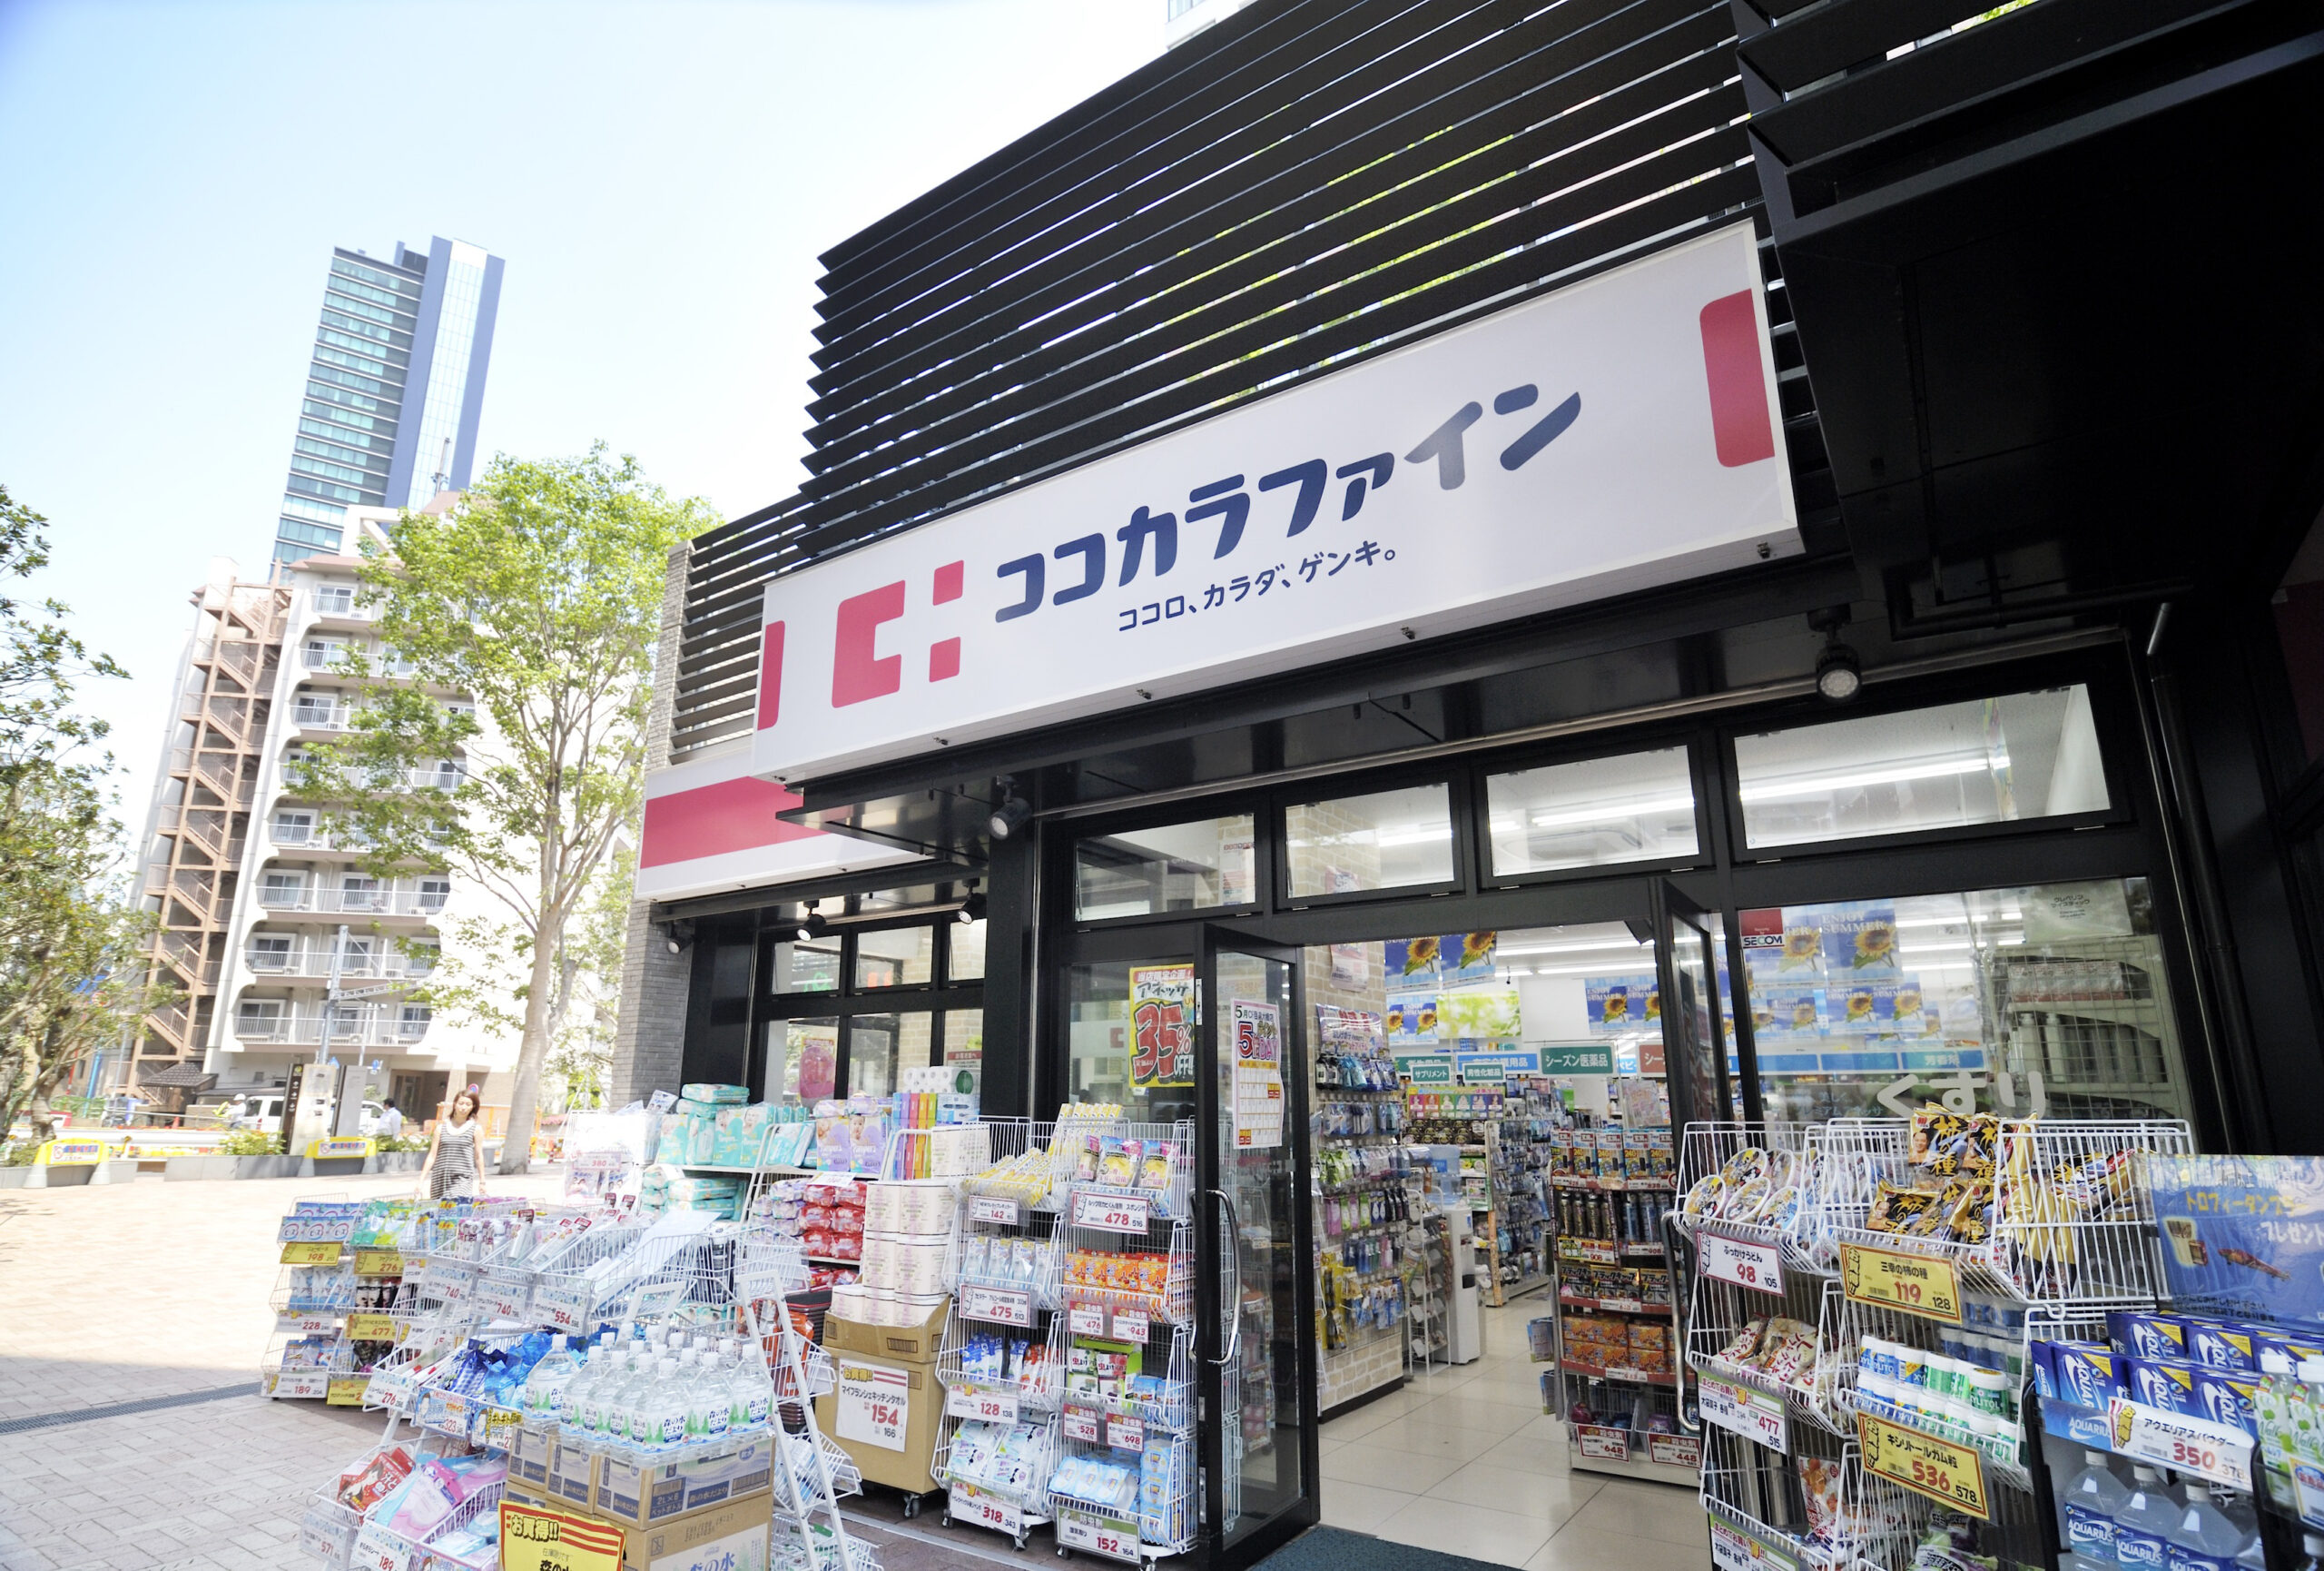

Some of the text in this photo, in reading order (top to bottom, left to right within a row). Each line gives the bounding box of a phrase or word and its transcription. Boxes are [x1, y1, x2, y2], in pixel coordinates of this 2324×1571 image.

[995, 383, 1581, 622] ココカラファイン
[1118, 542, 1396, 633] ココロ、カラダ、ゲンキ。
[1822, 913, 1865, 924] ENJOY
[1821, 922, 1886, 934] SUMMER
[1743, 935, 1783, 946] SECOM
[1546, 1052, 1608, 1067] シーズン医薬品
[1645, 1052, 1666, 1065] シー
[1414, 1070, 1448, 1079] サプリメント
[1467, 1068, 1502, 1077] 男性化粧品
[1876, 1070, 2046, 1120] くすり
[991, 1210, 1005, 1219] 142
[1105, 1212, 1129, 1225] 478
[307, 1253, 324, 1261] 198
[1724, 1245, 1763, 1263] ぶっかけうどん
[379, 1263, 398, 1271] 276
[1881, 1260, 1929, 1280] 三幸の柿の種
[1737, 1263, 1777, 1289] 98 105
[444, 1286, 460, 1299] 740
[1894, 1280, 1951, 1310] 119 128
[496, 1302, 512, 1316] 740
[990, 1305, 1025, 1320] 475 513
[554, 1311, 571, 1325] 554
[1086, 1320, 1101, 1329] 476
[302, 1321, 320, 1330] 228
[371, 1328, 390, 1336] 477
[1130, 1326, 1147, 1336] 943
[294, 1386, 310, 1394] 189
[381, 1391, 397, 1406] 276
[872, 1404, 899, 1427] 154
[980, 1401, 1000, 1416] 128
[1002, 1409, 1013, 1418] 138
[445, 1418, 457, 1433] 323
[1079, 1425, 1095, 1435] 528
[1758, 1416, 1779, 1436] 477
[2143, 1418, 2237, 1447] アクエリアスパウダー
[884, 1428, 896, 1438] 166
[1125, 1435, 1141, 1445] 698
[1768, 1436, 1780, 1448] 515
[1604, 1445, 1624, 1454] 648
[1887, 1434, 1958, 1468] キシリトールガム粒
[1676, 1453, 1697, 1462] 448
[2172, 1442, 2245, 1479] 350 378
[1912, 1459, 1977, 1503] 536 578
[982, 1506, 1016, 1529] 318 343
[511, 1515, 560, 1542] お買得!!
[2068, 1518, 2115, 1542] AQUARIUS
[1097, 1536, 1134, 1556] 152 164
